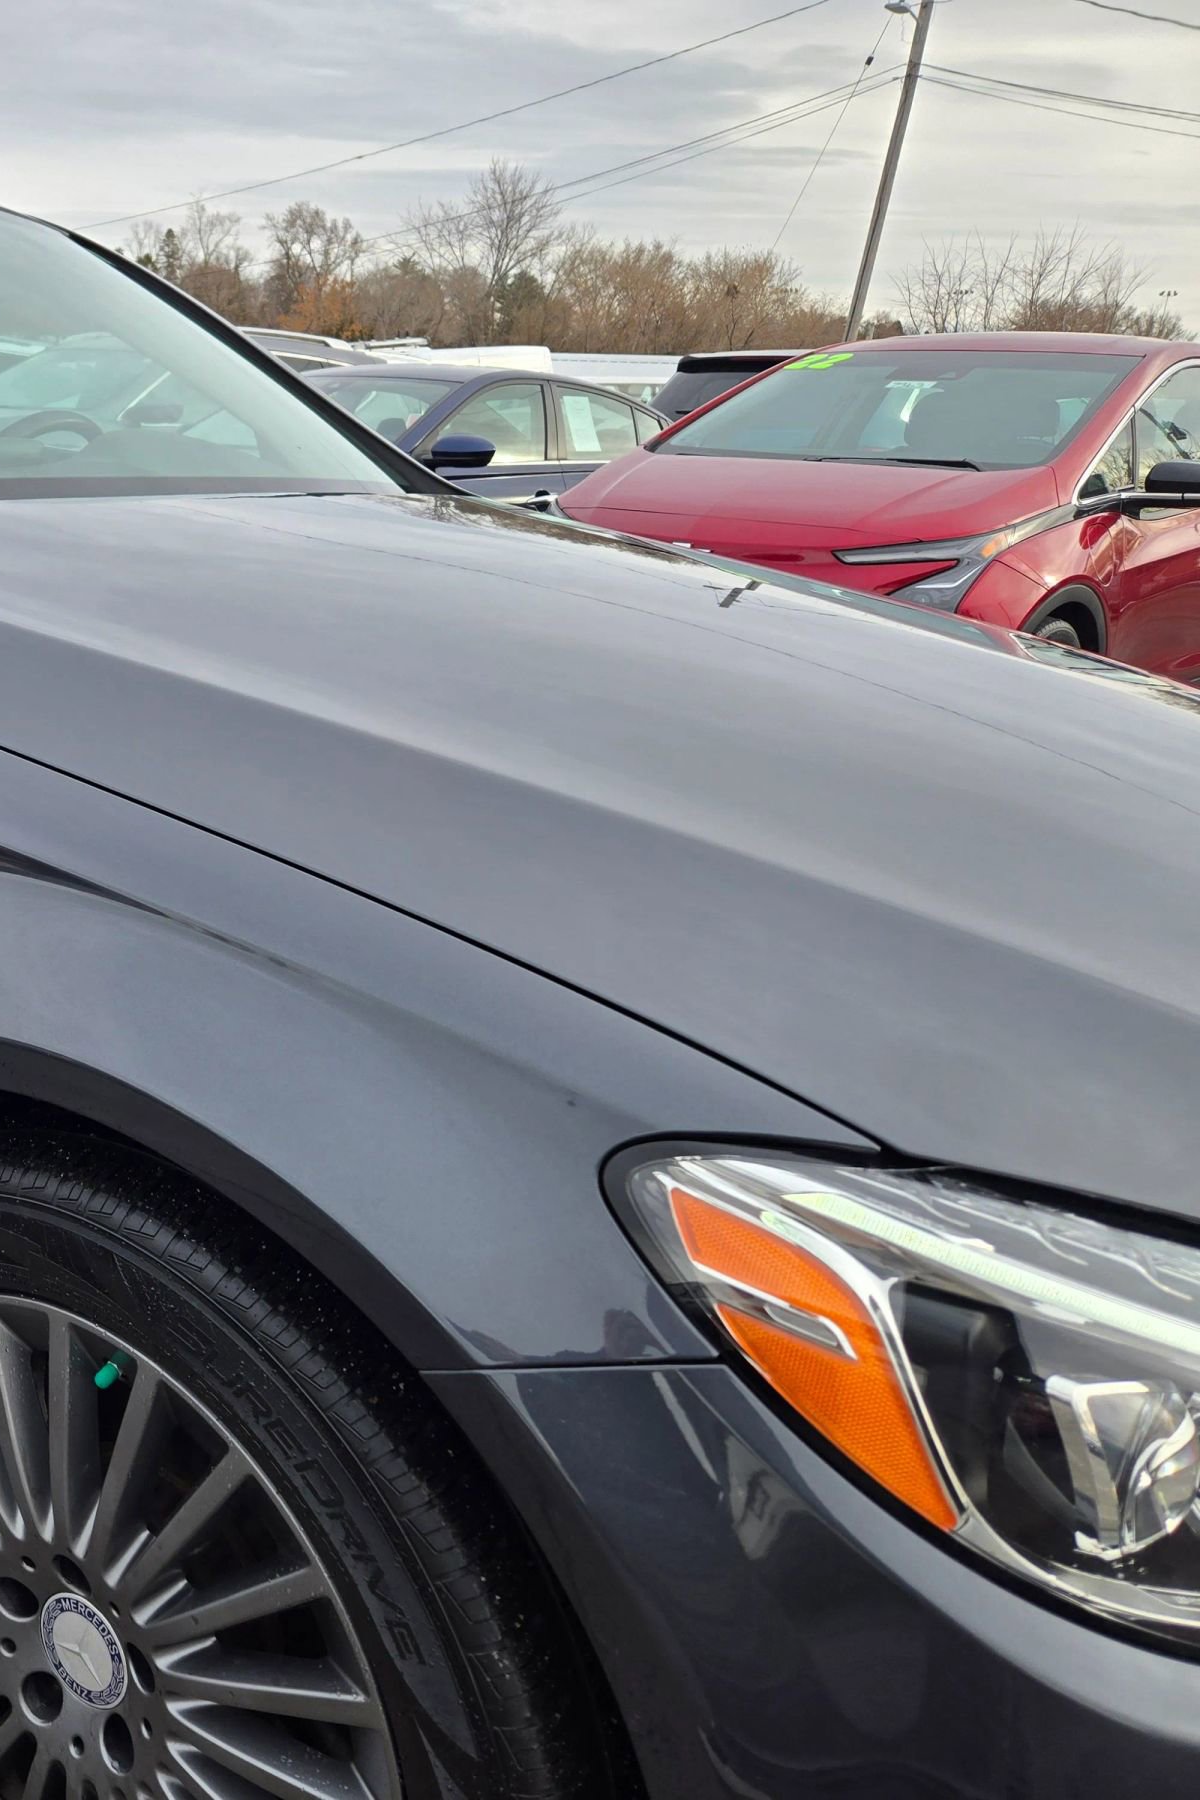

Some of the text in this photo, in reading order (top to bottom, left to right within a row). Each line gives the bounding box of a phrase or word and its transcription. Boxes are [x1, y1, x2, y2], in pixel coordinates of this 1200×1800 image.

[784, 352, 854, 370] 22
[61, 1598, 119, 1656] MERCEDES
[58, 1665, 91, 1700] BENZ
